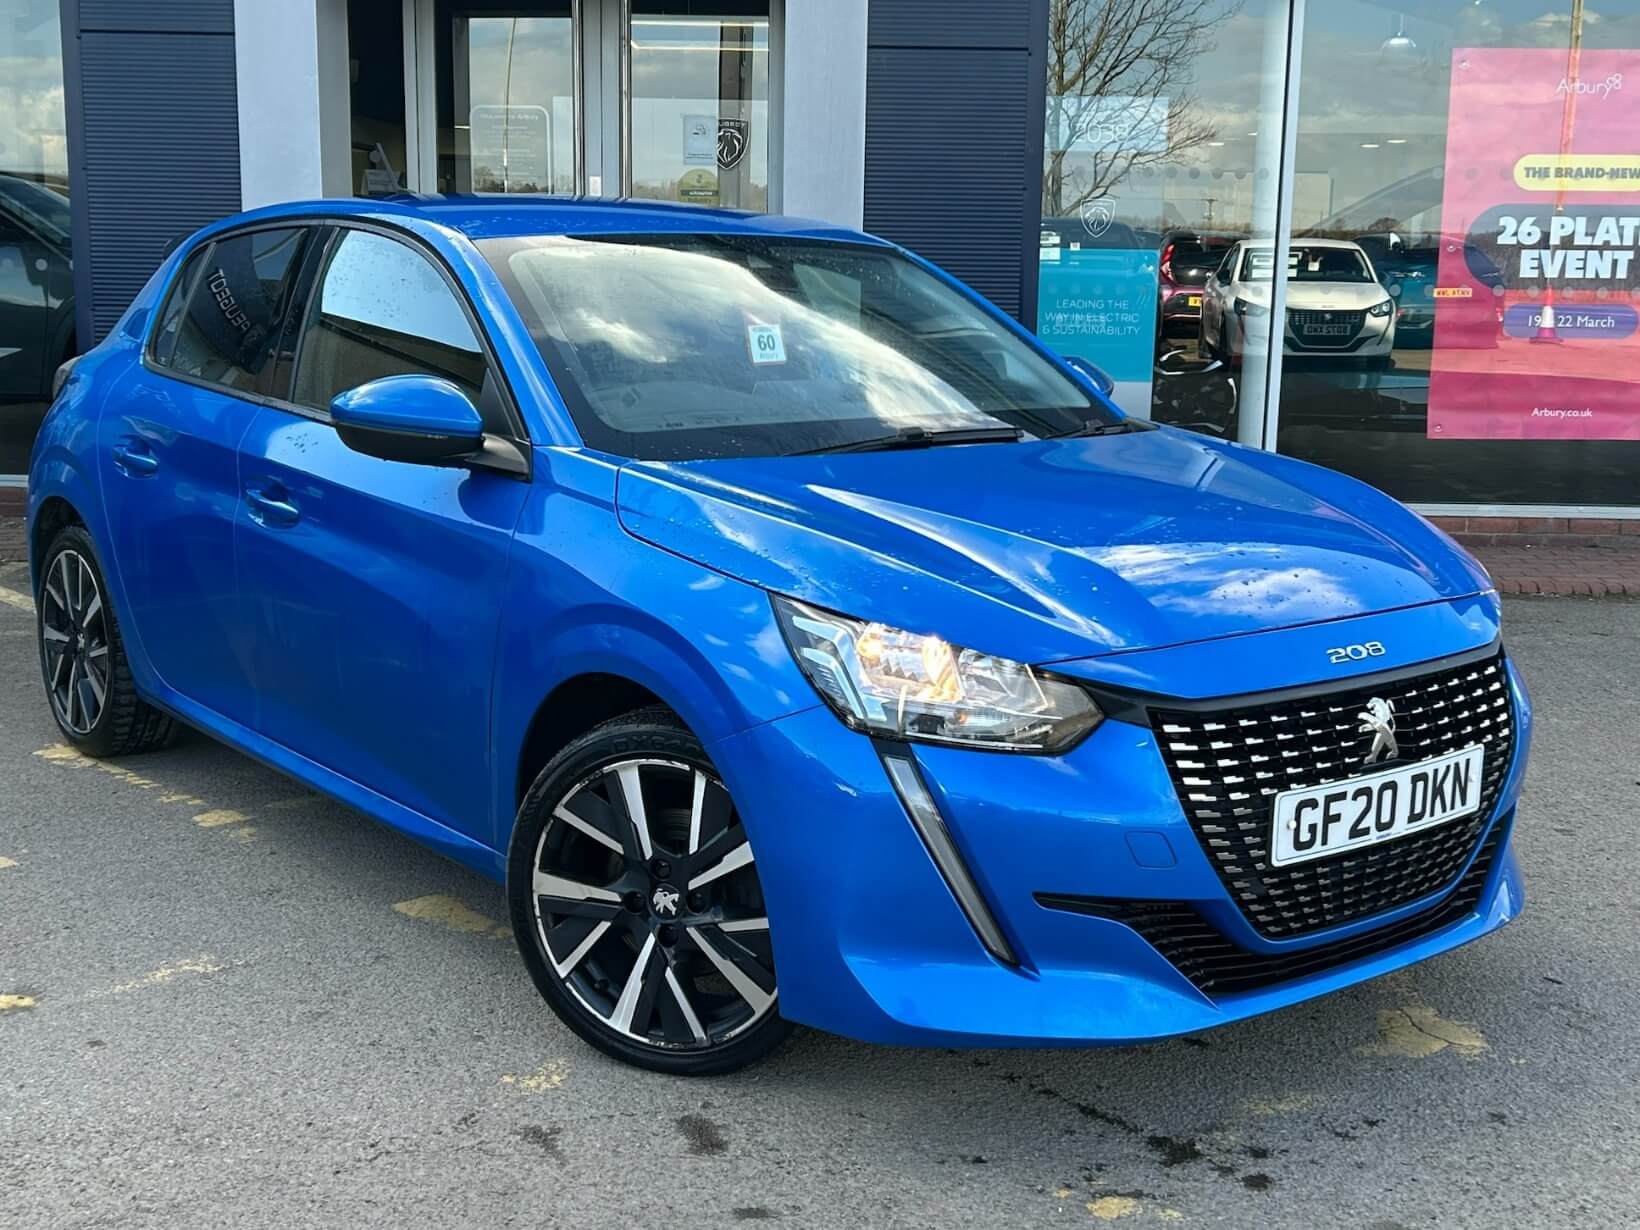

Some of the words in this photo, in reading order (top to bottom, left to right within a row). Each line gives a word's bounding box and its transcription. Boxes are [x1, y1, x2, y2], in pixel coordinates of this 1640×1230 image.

[1556, 77, 1612, 100] Arbury
[1524, 167, 1550, 178] THE
[1554, 167, 1640, 179] BRAND-NEW
[1496, 216, 1541, 246] 26
[1549, 216, 1640, 246] PLAT
[1519, 249, 1634, 279] EVENT
[1056, 299, 1105, 309] LEADING
[1107, 299, 1129, 309] THE
[1045, 312, 1070, 321] WAY
[1072, 312, 1083, 321] IN
[1086, 312, 1140, 323] ELECTRIC
[1528, 315, 1540, 327] 19
[1557, 315, 1573, 327] 22
[1576, 315, 1615, 328] March
[1052, 324, 1140, 336] SUSTAINABILITY
[757, 334, 776, 351] 60
[1531, 407, 1593, 418] Arbury.co.uk
[1326, 641, 1386, 664] 208
[1292, 780, 1398, 852] GF20
[1407, 758, 1471, 825] DKN
